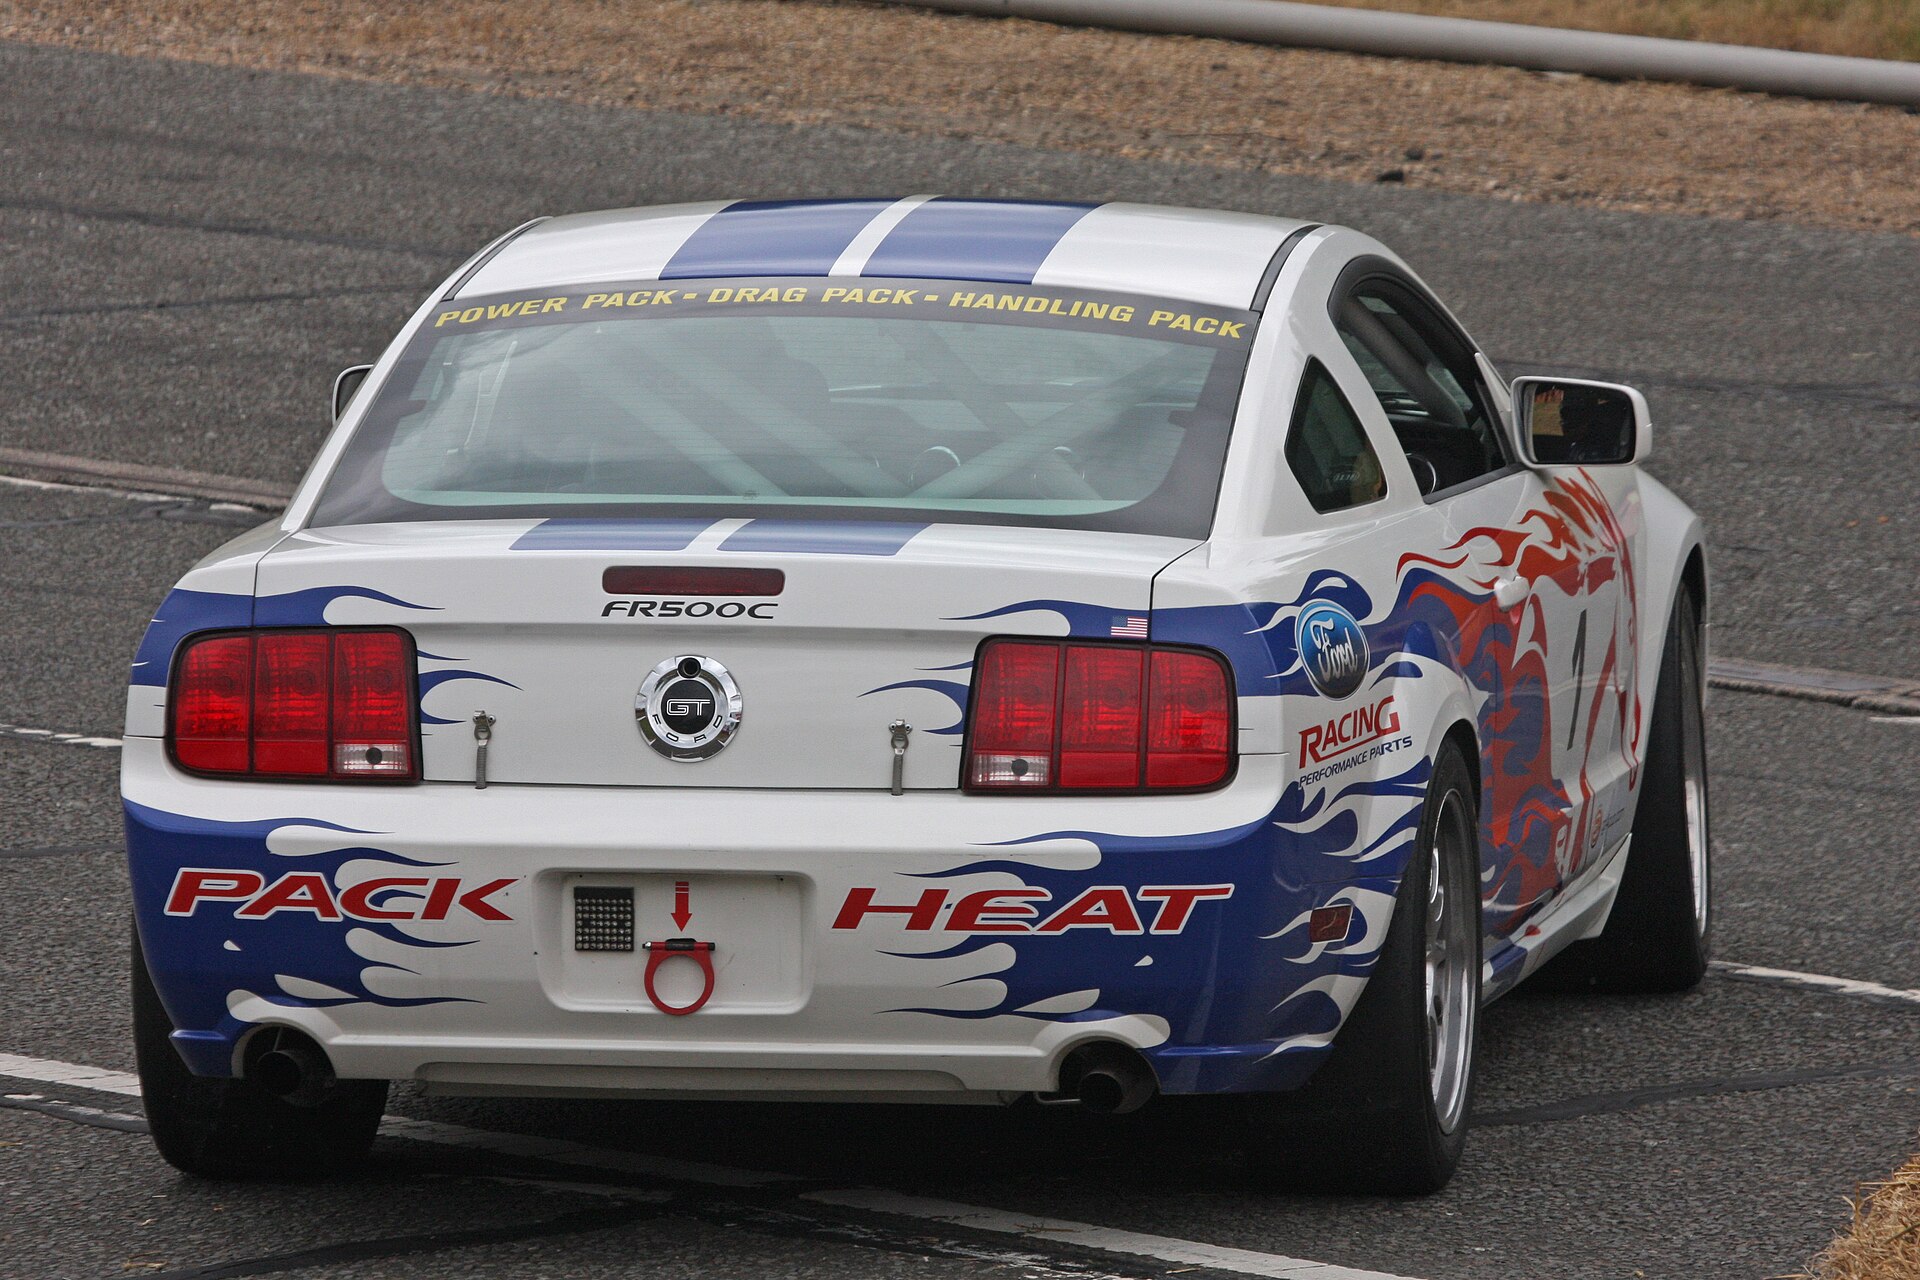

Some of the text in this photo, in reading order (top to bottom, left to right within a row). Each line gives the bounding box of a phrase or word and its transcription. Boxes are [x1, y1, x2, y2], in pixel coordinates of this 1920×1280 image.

[435, 297, 568, 328] POWER
[582, 291, 677, 309] PACK
[708, 287, 807, 303] DRAG
[821, 288, 918, 305] PACK
[949, 292, 1135, 323] HANDLING
[1148, 310, 1246, 339] PACK
[601, 600, 778, 619] FR500C
[1309, 617, 1358, 682] Ford
[652, 714, 723, 743] FORD
[666, 698, 711, 716] GT
[1298, 695, 1400, 769] RACING
[1299, 735, 1413, 788] PERFORMANCE PARTS
[164, 867, 1235, 935] PACK HEAT
